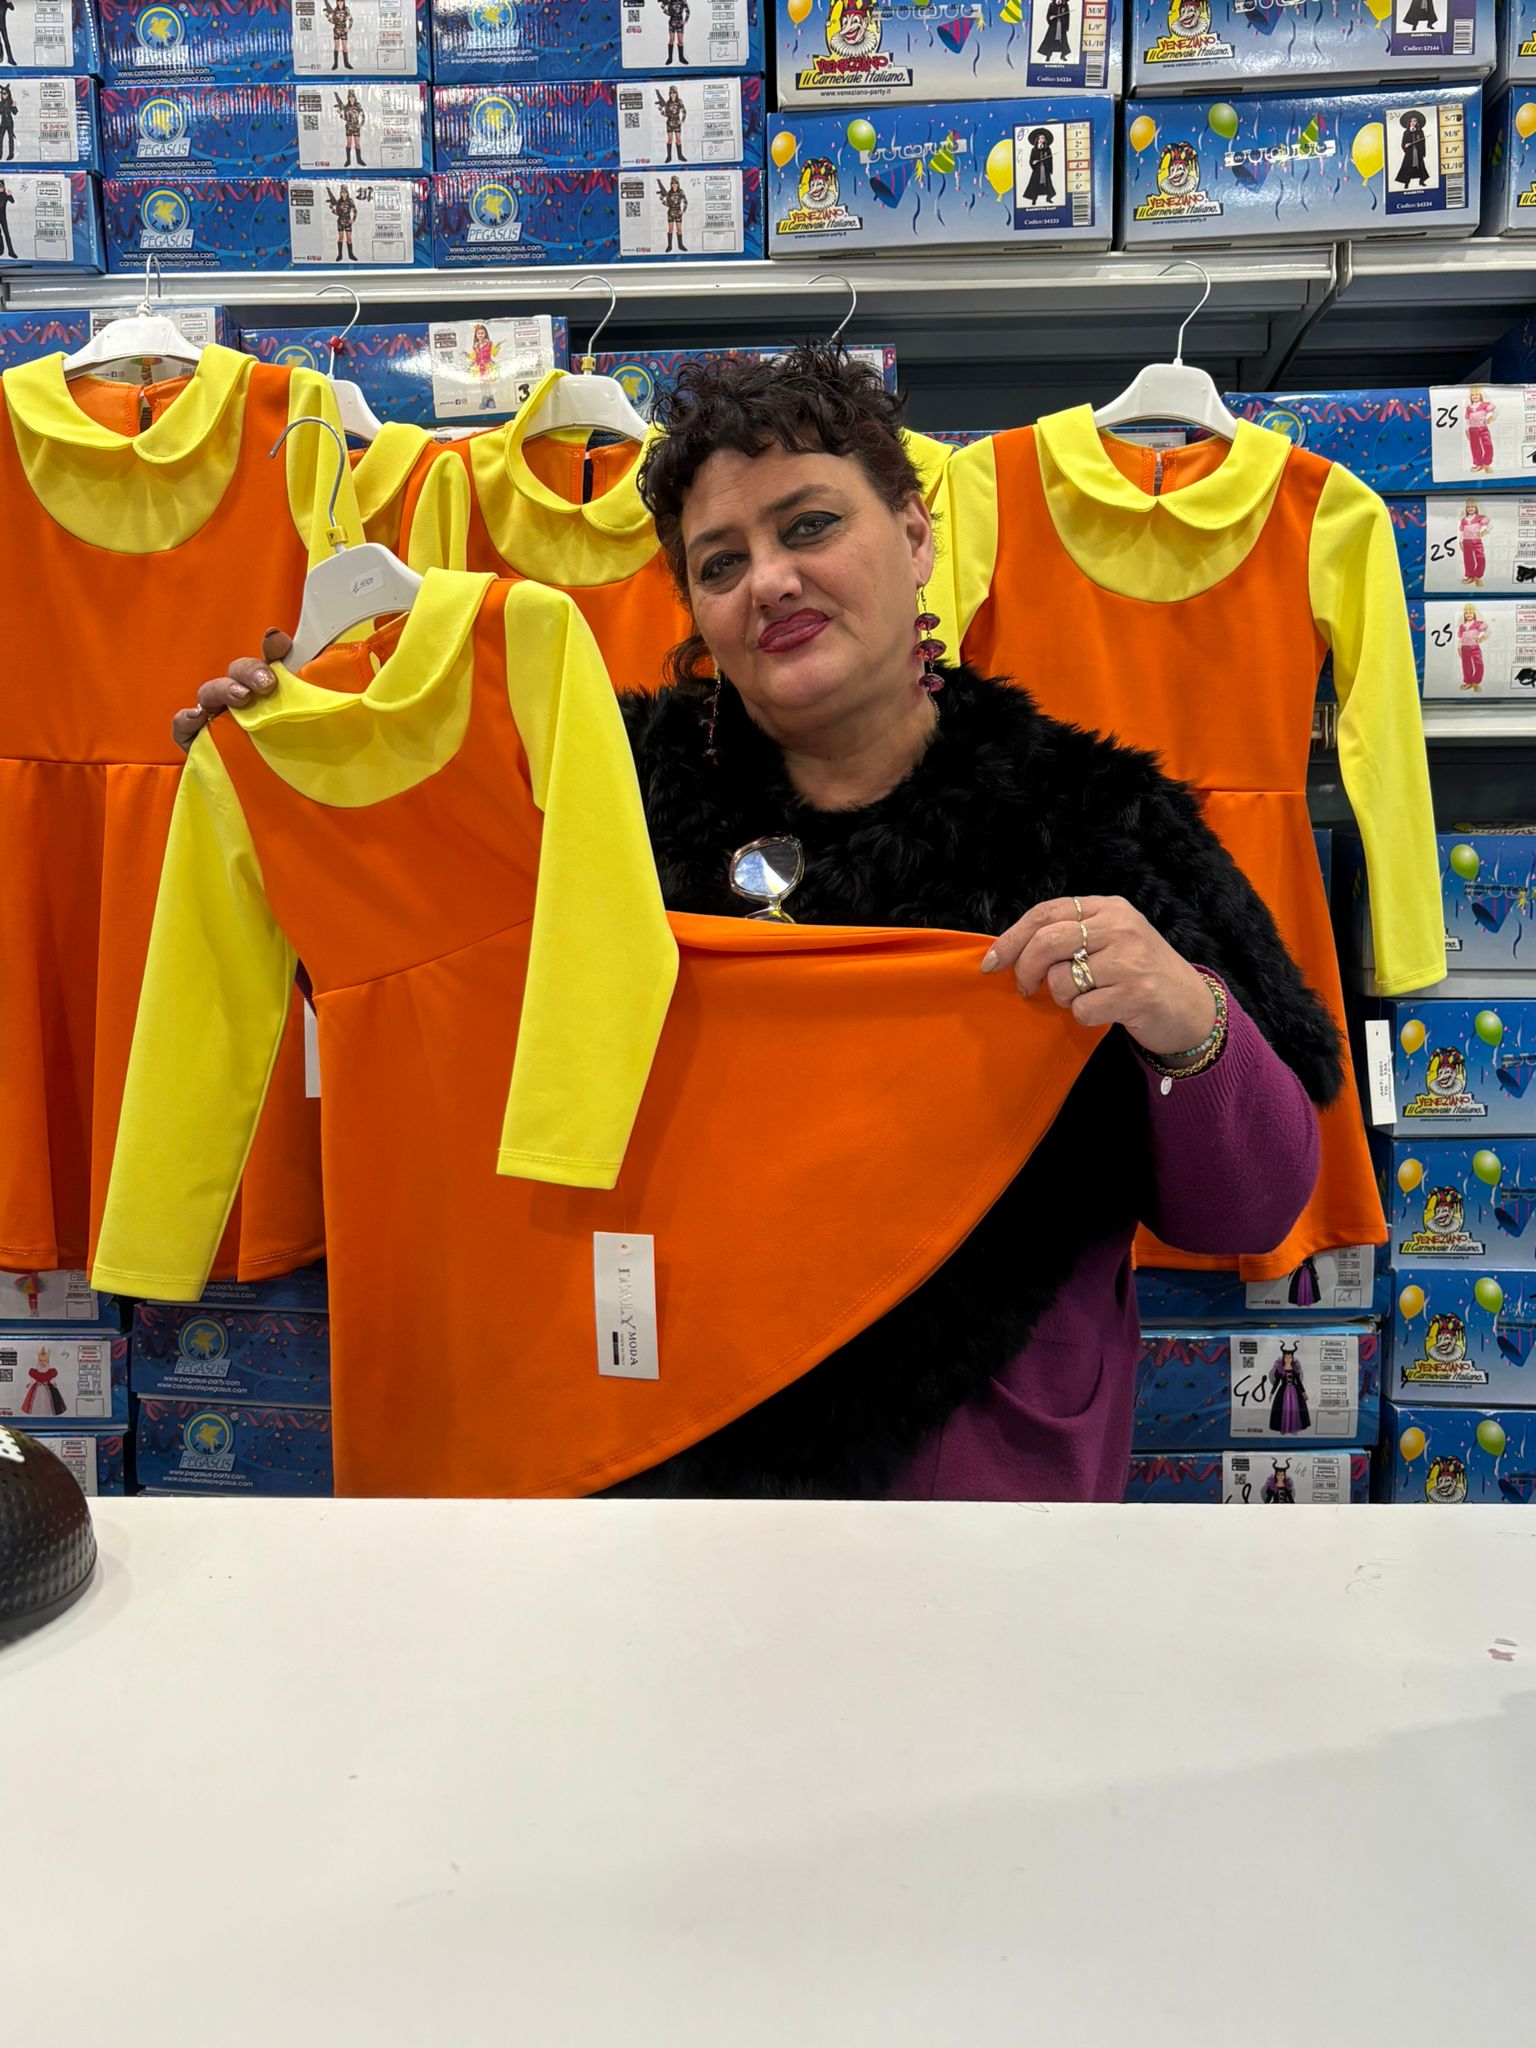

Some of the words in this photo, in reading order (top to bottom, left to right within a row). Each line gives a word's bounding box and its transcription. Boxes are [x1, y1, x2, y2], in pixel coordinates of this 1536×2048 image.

[1161, 35, 1216, 50] VENEZIANO
[1149, 50, 1156, 60] Il
[1156, 49, 1196, 60] Carnevale
[1197, 46, 1230, 57] Italiano.
[816, 55, 889, 74] VENEZIANO
[802, 71, 811, 85] Il
[811, 71, 862, 85] Carnevale
[864, 70, 906, 83] Italiano.
[820, 88, 892, 97] www.veneziano-party.it
[138, 143, 188, 156] PEGASUS
[119, 160, 212, 169] www.carnevalepegasus.com
[116, 168, 217, 177] carnevalepegasus@gmail.com
[1150, 194, 1205, 209] VENEZIANO
[792, 208, 845, 223] VENEZIANO
[1138, 207, 1146, 217] Il
[1146, 206, 1186, 217] Carnevale
[1187, 204, 1218, 215] Italiano.
[788, 221, 826, 231] Carnevale
[826, 219, 858, 229] Italiano.
[141, 234, 191, 247] PEGASUS
[468, 228, 519, 241] PEGASUS
[449, 245, 542, 254] www.carnevalepegasus.com
[445, 253, 547, 261] carnevalepegasus@gmail.com
[1436, 405, 1459, 429] 25
[1430, 536, 1458, 561] 25
[1431, 623, 1453, 648] 25
[1418, 1097, 1471, 1107] VENEZIANO
[1413, 1106, 1451, 1114] Carnevale
[1452, 1105, 1483, 1114] Italiano.
[1415, 1234, 1468, 1245] VENEZIANO
[1411, 1243, 1449, 1252] Carnevale
[1450, 1243, 1480, 1252] Italiano.
[628, 1331, 639, 1366] MODA
[176, 1361, 227, 1376] PEGASUS
[1417, 1363, 1471, 1373] VENEZIANO
[163, 1376, 241, 1386] www.pegasus-party.com
[1413, 1371, 1452, 1380] Carnevale
[1453, 1372, 1484, 1381] Italiano.
[157, 1382, 248, 1394] www.carnevalepegasus.com
[180, 1456, 231, 1470] PEGASUS
[169, 1470, 246, 1480] www.pegasus-party.com
[162, 1476, 253, 1487] www.carnevalepegasus.com
